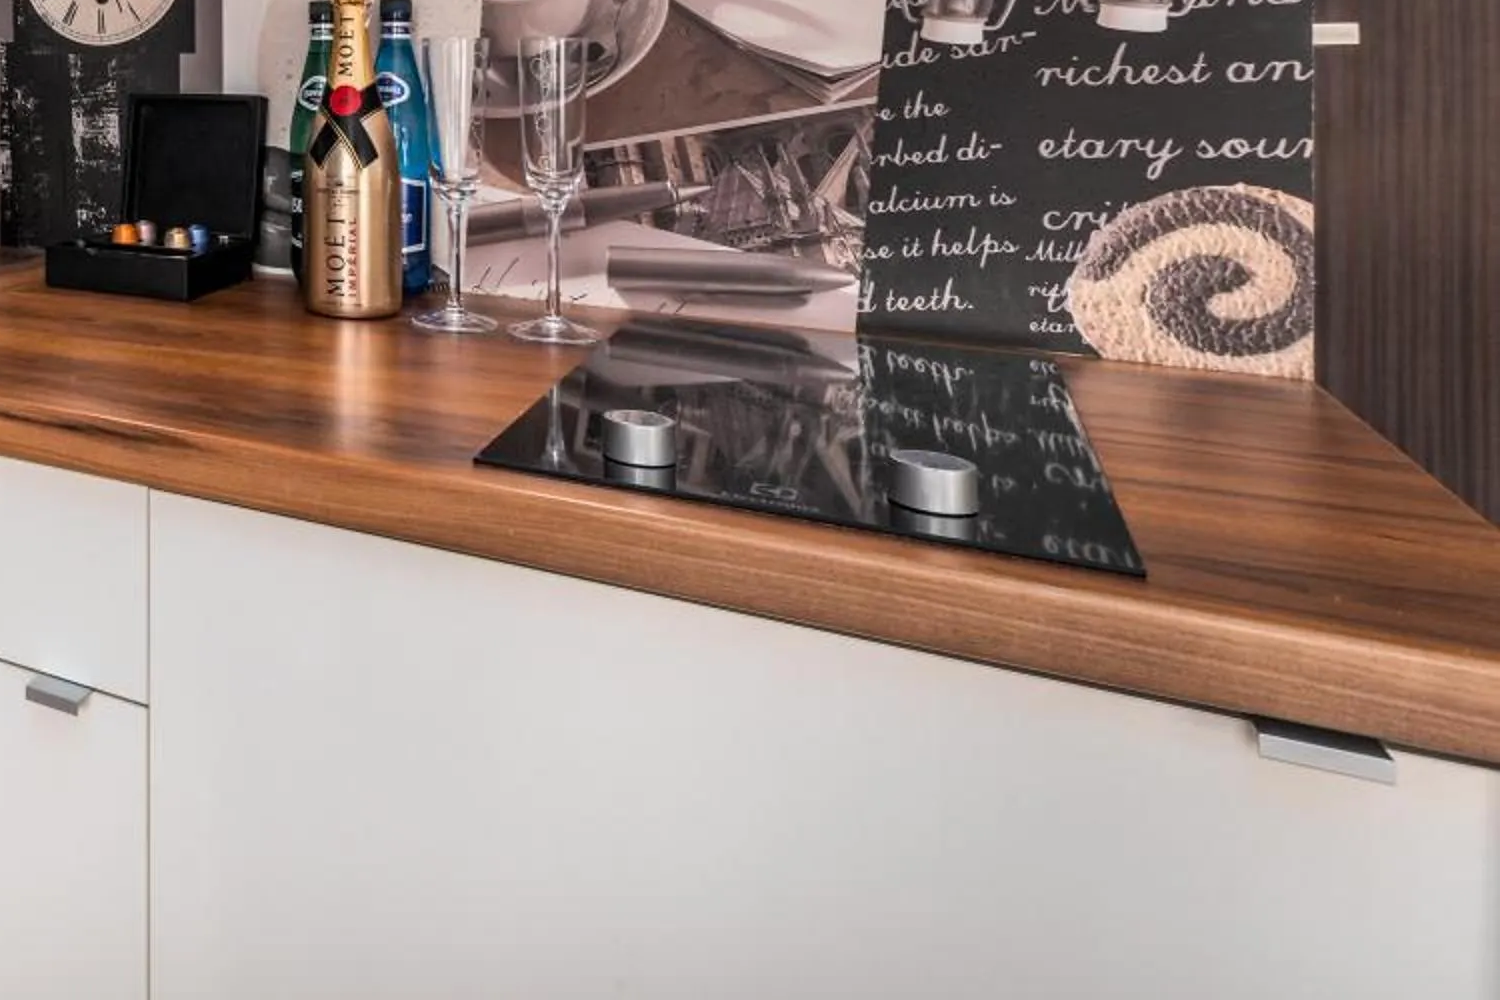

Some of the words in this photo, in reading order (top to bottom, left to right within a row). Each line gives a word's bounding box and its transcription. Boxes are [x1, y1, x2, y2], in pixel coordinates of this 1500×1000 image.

[1034, 41, 1213, 87] richest
[1225, 59, 1314, 84] an
[903, 88, 952, 120] the
[955, 130, 1003, 161] di-
[1037, 127, 1184, 181] etary
[989, 184, 1018, 207] is
[902, 237, 925, 257] it
[931, 225, 1021, 270] helps
[885, 276, 976, 312] teeth.
